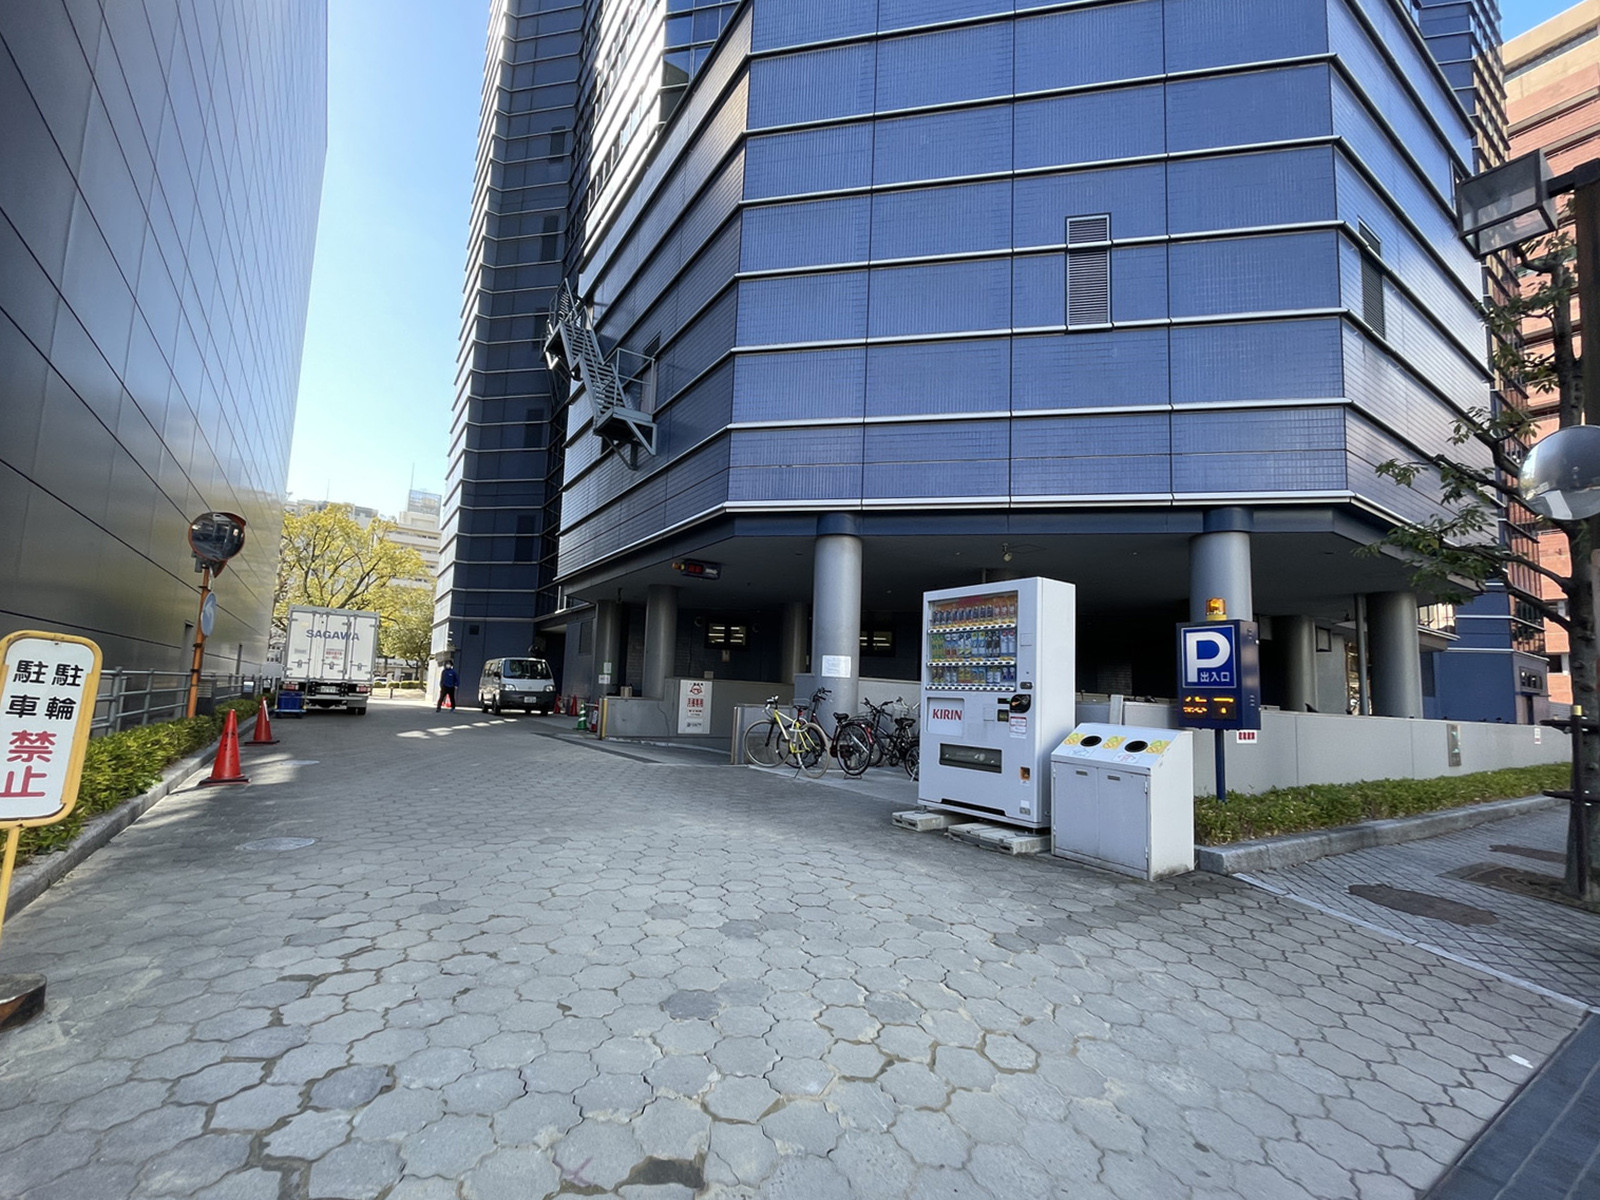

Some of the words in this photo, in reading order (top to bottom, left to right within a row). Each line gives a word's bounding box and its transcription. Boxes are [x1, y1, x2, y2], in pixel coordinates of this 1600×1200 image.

[306, 629, 360, 641] SAGAWA
[1185, 631, 1231, 683] P
[5, 659, 49, 719] 駐車
[44, 663, 84, 721] 駐輪
[1200, 671, 1230, 683] 出入口
[932, 708, 963, 721] KIRIN
[0, 729, 57, 798] 禁止
